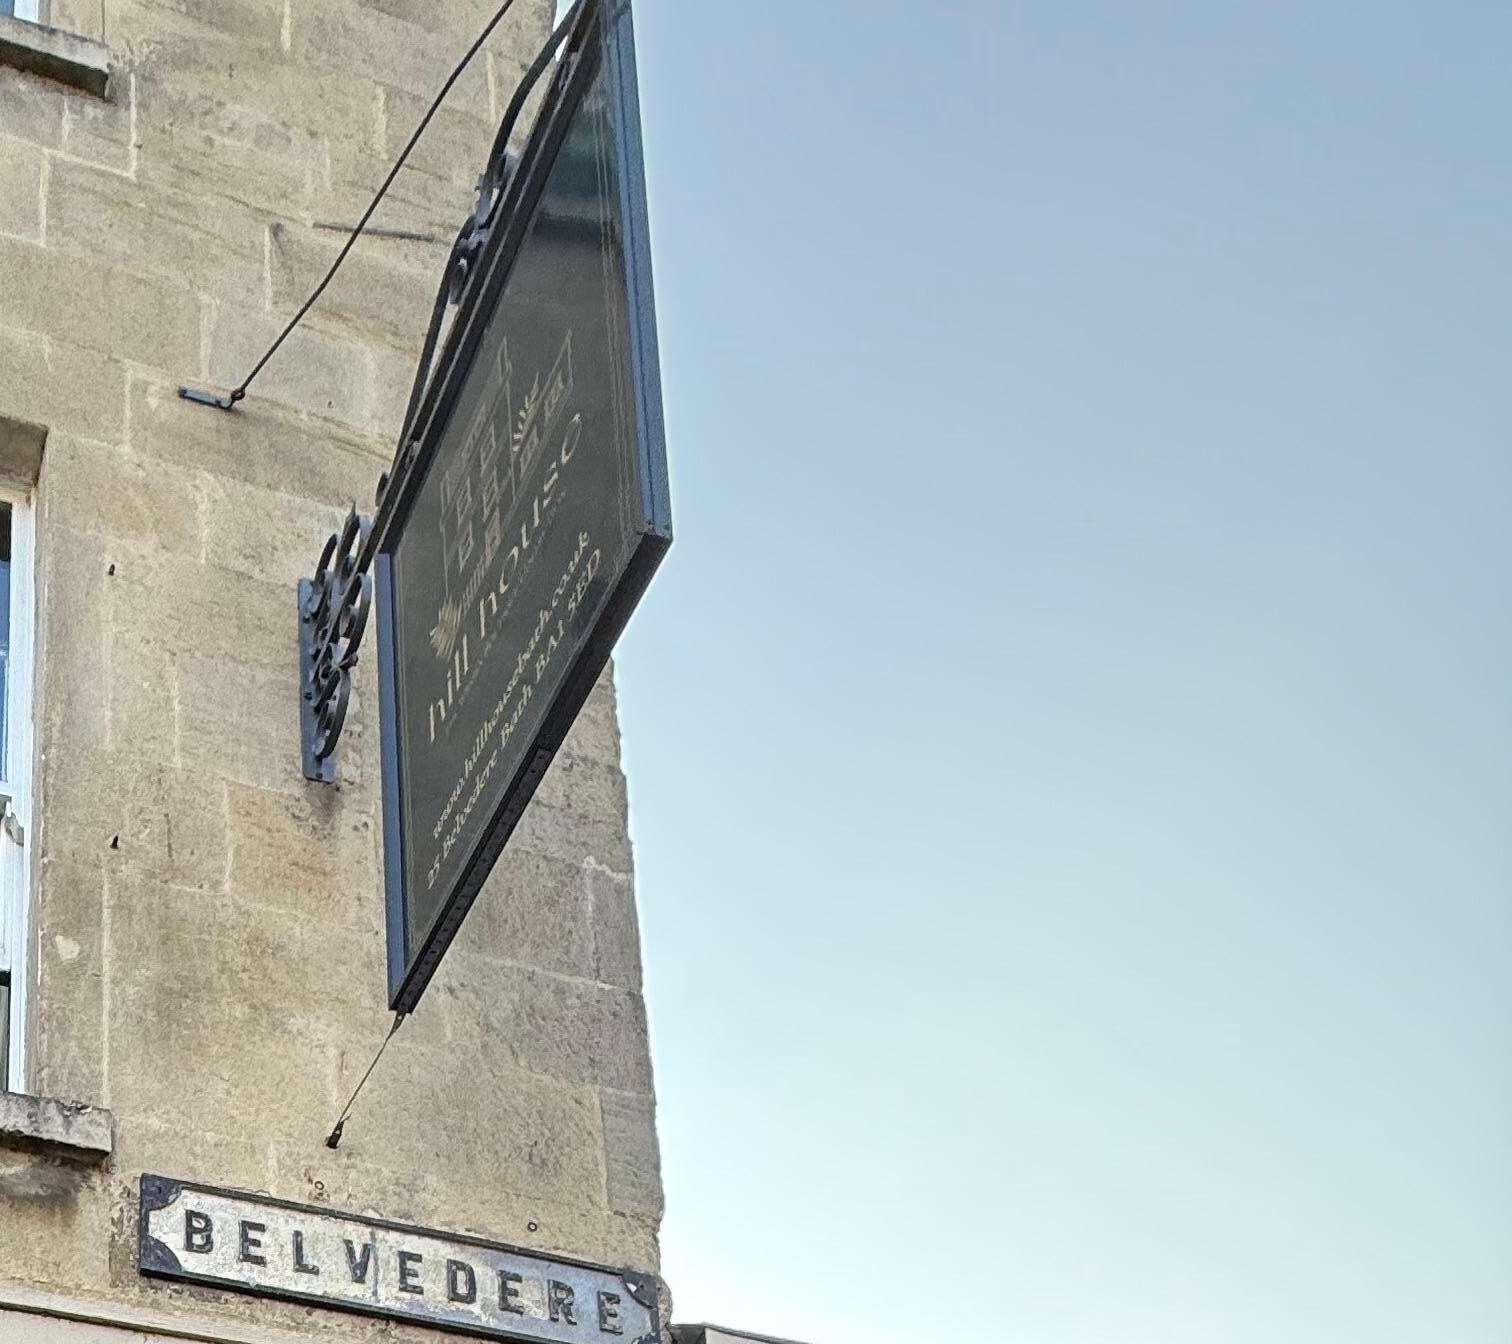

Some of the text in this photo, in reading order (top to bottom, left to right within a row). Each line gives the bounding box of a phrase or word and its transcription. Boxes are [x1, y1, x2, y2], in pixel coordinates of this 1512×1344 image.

[429, 632, 470, 744] hill
[479, 412, 584, 640] house
[442, 748, 499, 861] Belvedere
[500, 684, 534, 749] Bath
[183, 1208, 624, 1336] BELVEDERE
